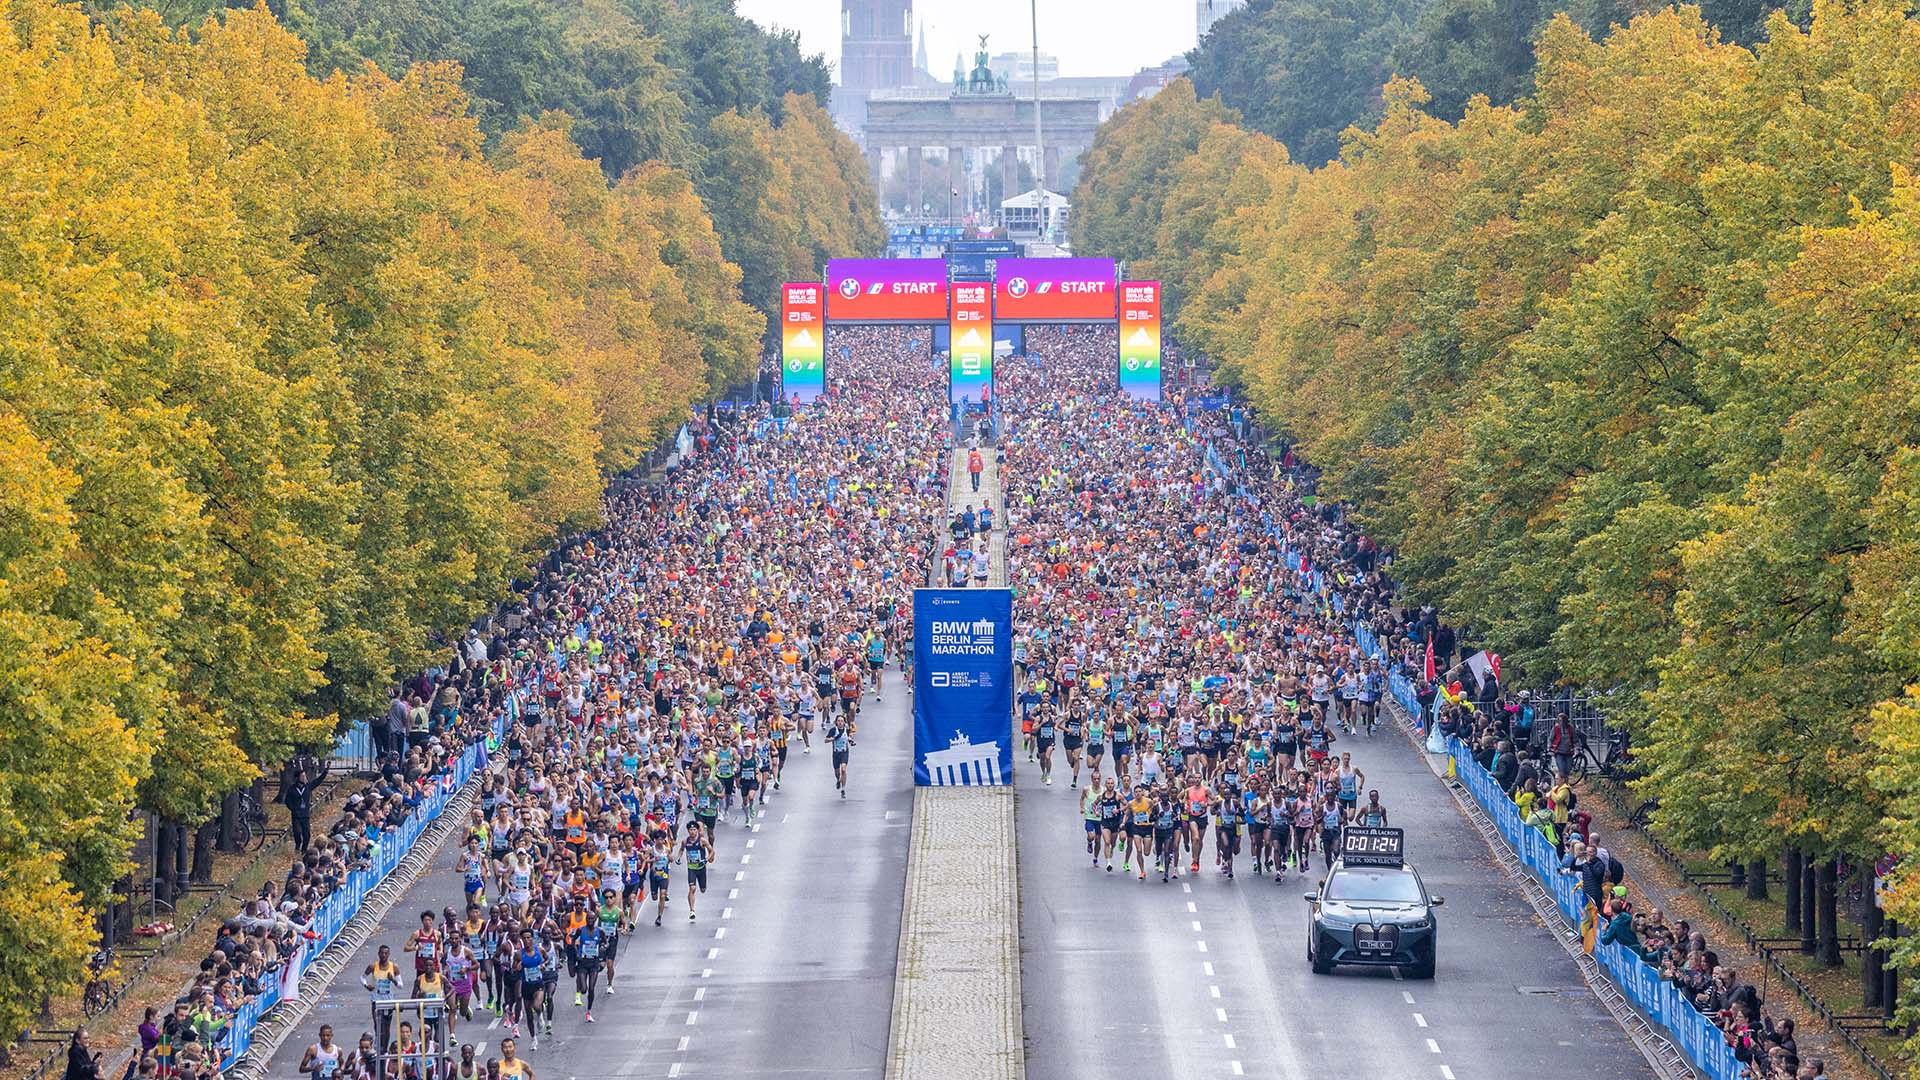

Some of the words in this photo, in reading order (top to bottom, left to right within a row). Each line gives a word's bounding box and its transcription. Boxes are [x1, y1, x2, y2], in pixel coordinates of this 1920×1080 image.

[892, 282, 938, 294] START
[1060, 281, 1106, 293] START
[932, 622, 970, 634] BMW
[932, 635, 970, 644] BERLIN
[932, 645, 994, 654] MARATHON
[1346, 836, 1398, 852] 0:01:24
